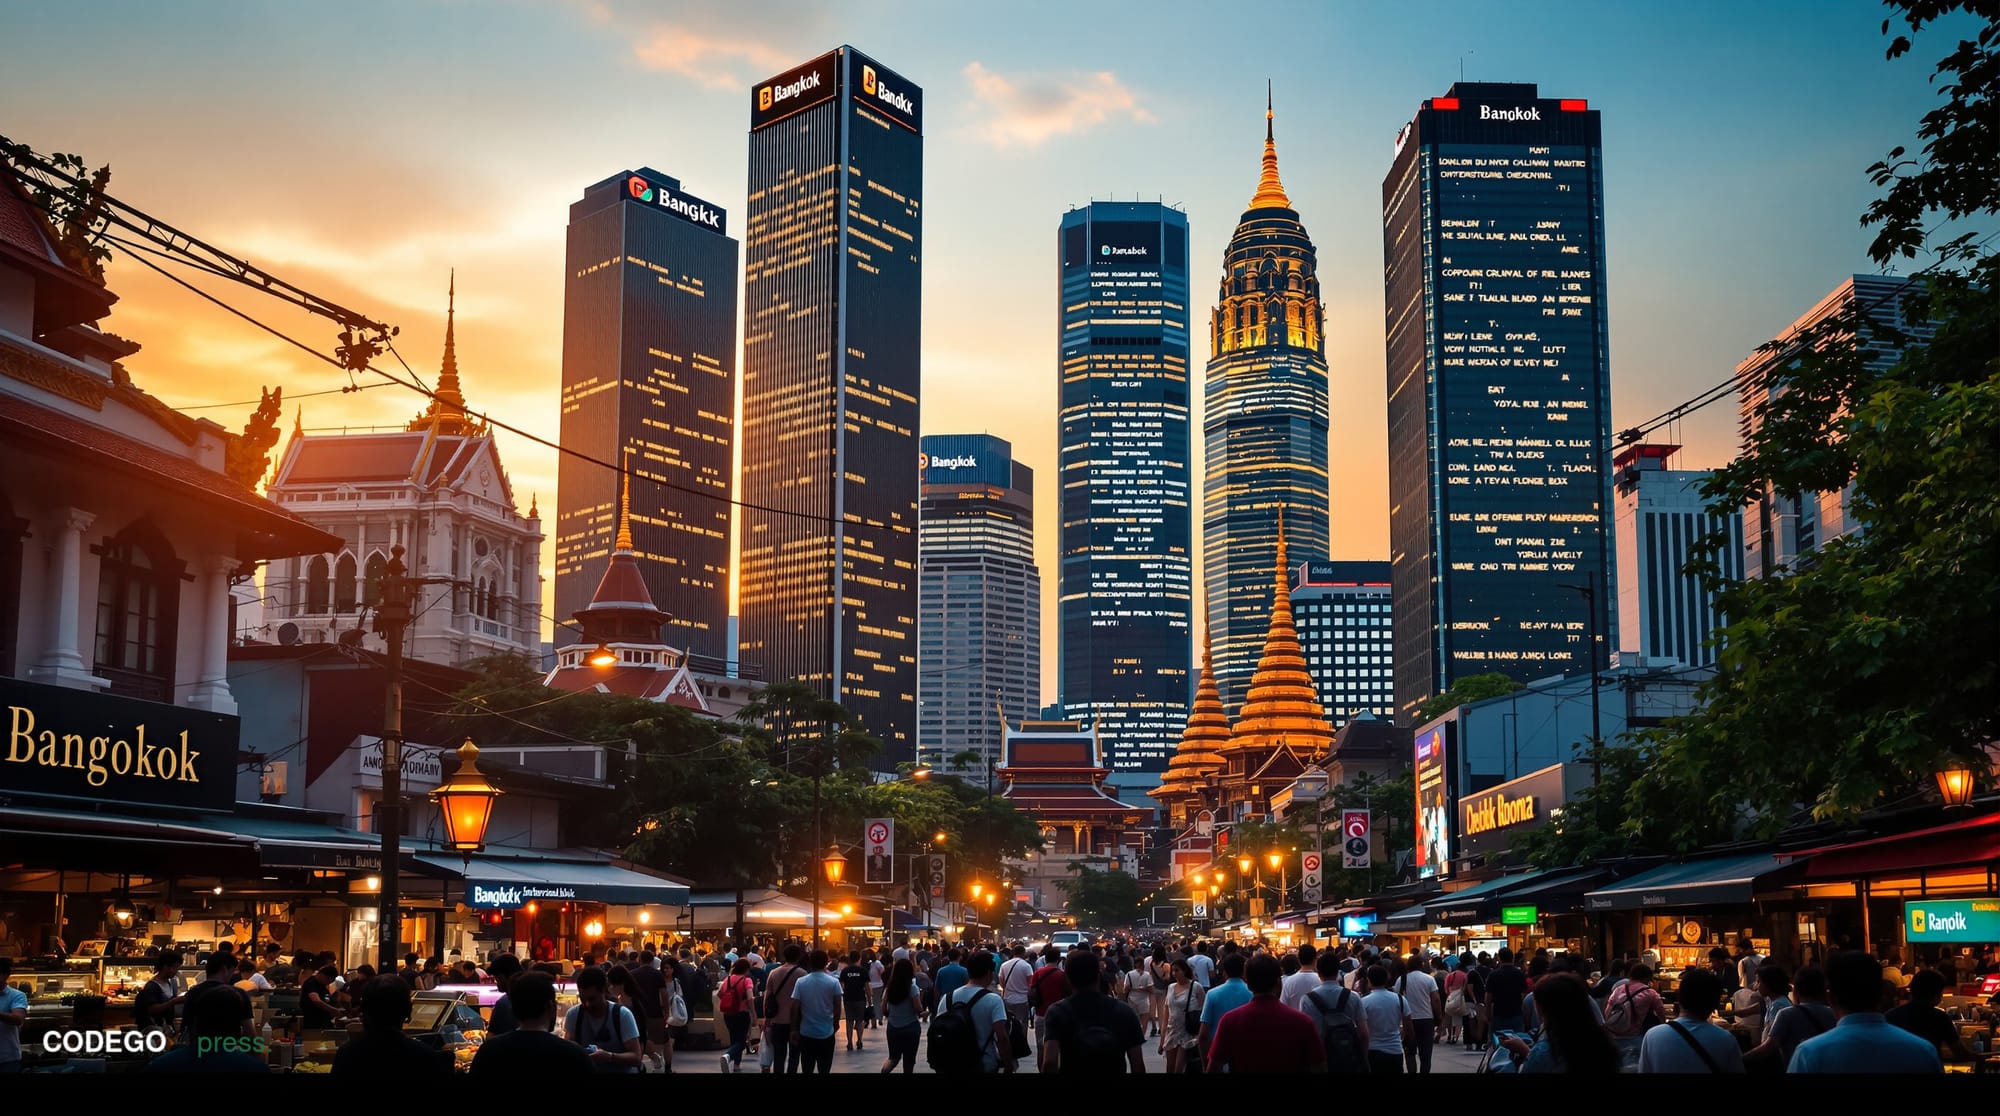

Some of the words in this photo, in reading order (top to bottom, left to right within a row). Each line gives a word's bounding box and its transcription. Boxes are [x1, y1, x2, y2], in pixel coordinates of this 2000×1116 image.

[774, 70, 820, 103] Bangkok
[1480, 105, 1541, 121] Bangkok
[931, 455, 977, 470] Bangkok
[5, 705, 200, 787] Bangokok
